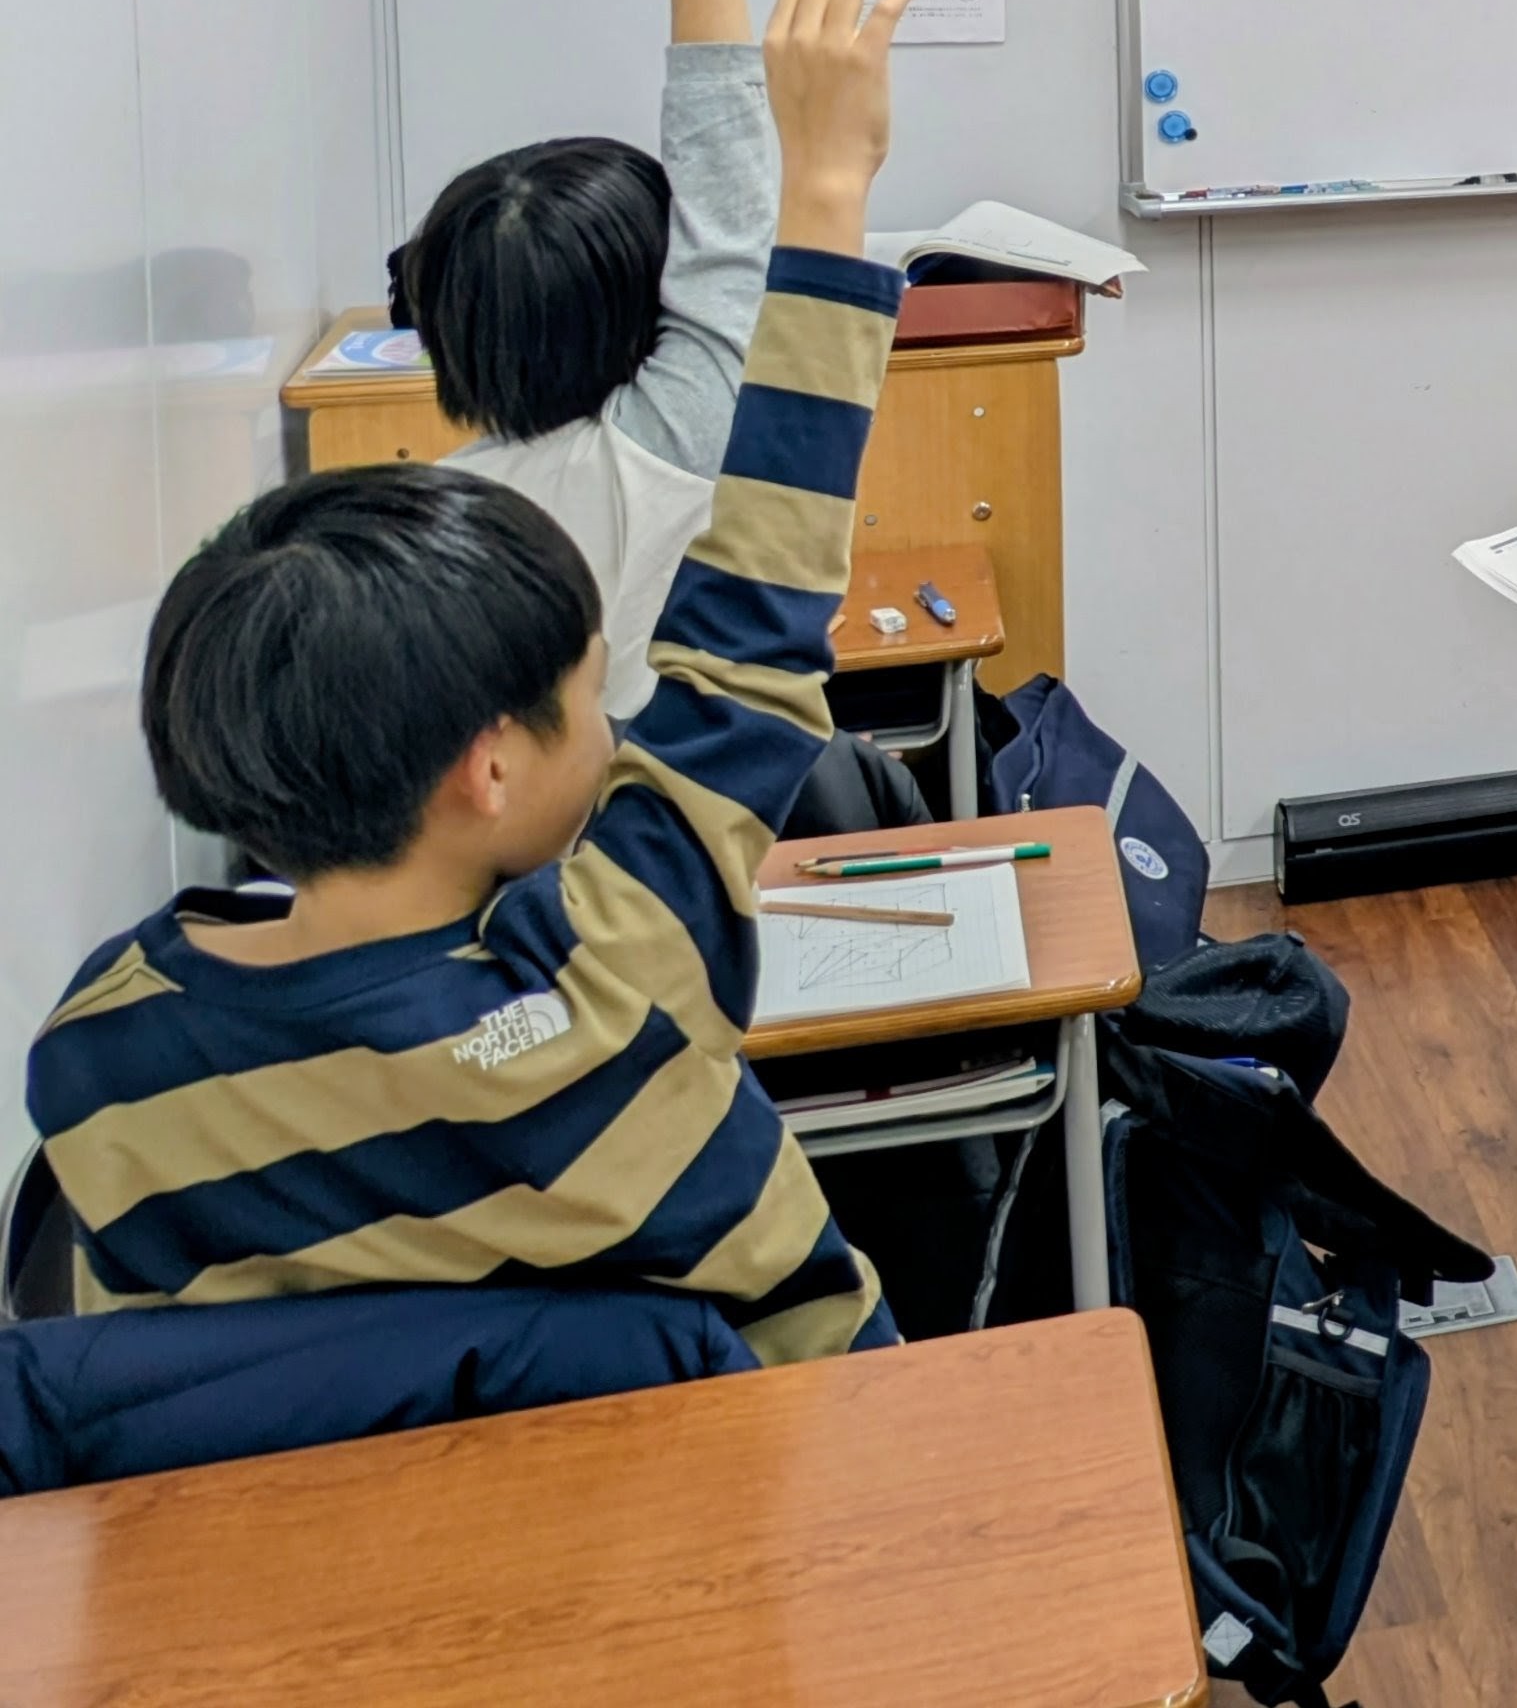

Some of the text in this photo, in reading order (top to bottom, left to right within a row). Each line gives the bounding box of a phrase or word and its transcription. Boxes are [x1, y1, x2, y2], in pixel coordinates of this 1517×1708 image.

[480, 998, 524, 1034] THE
[452, 1019, 529, 1064] NORTH
[480, 1034, 534, 1070] FACE
